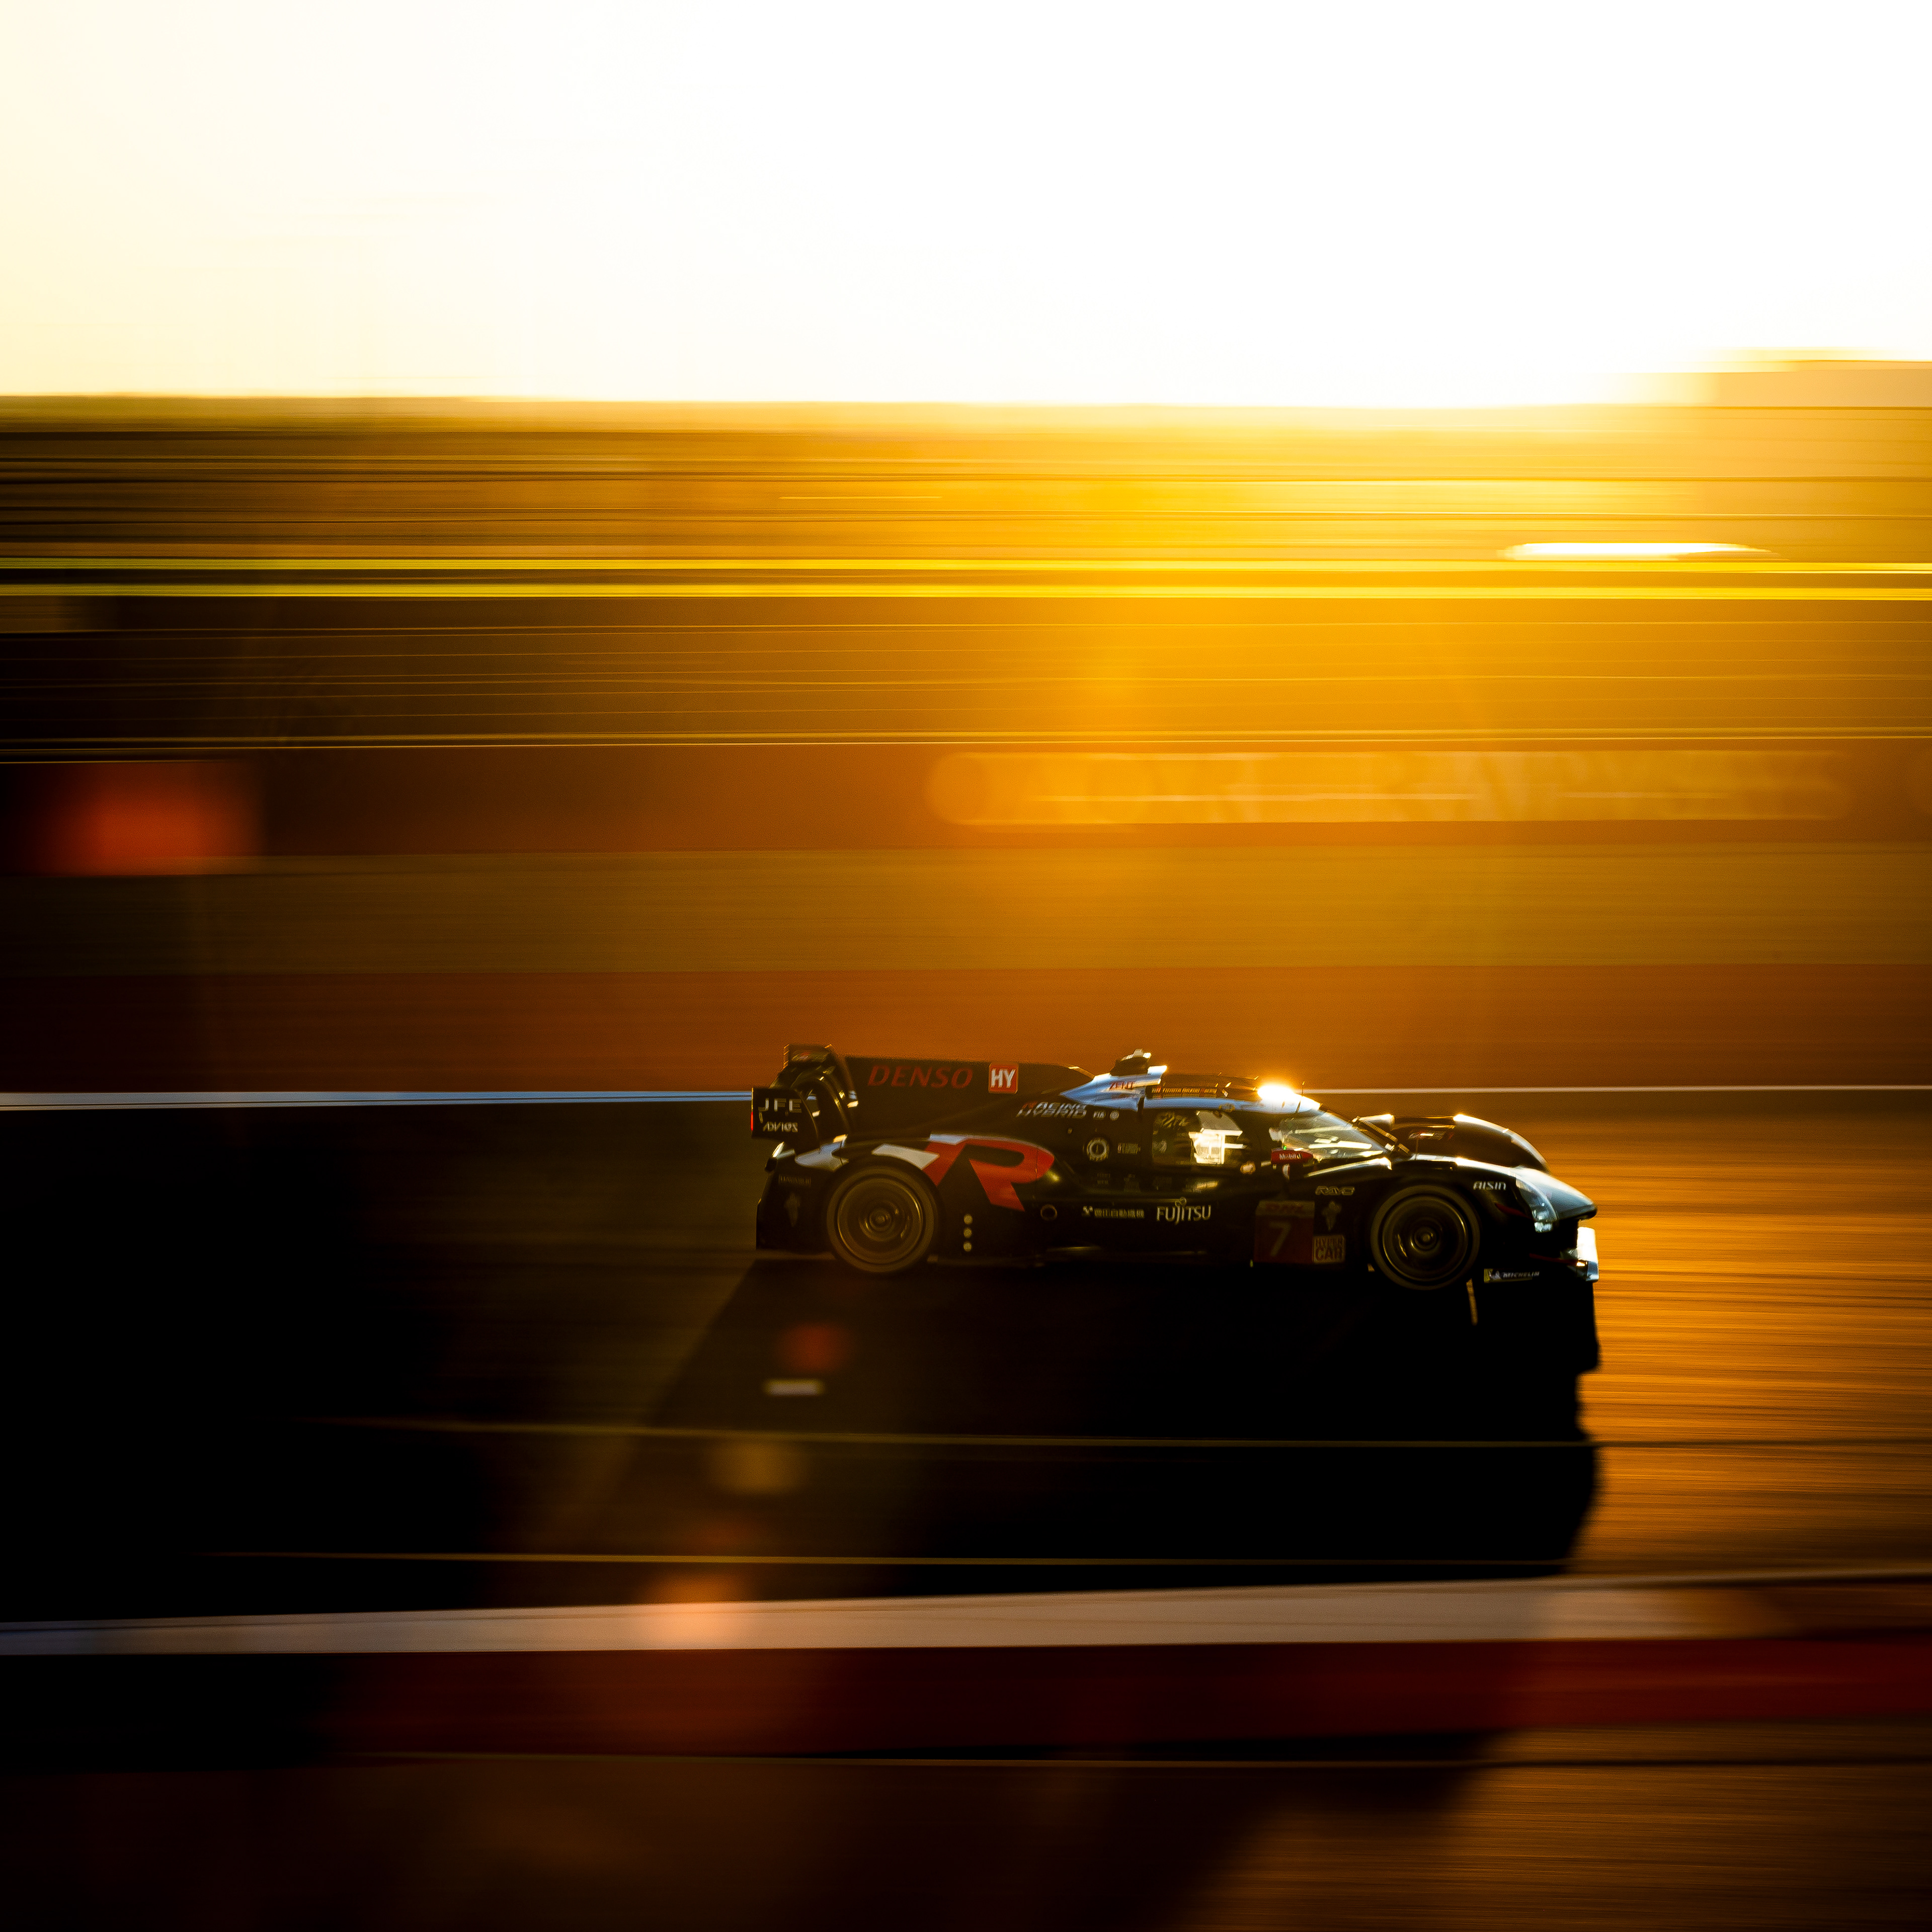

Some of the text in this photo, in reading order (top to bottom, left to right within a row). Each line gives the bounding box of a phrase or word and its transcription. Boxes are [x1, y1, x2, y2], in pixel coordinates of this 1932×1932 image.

[867, 1064, 974, 1089] DENSO
[990, 1068, 1016, 1089] HY
[758, 1097, 802, 1113] JFE
[1473, 1181, 1506, 1190] AISIN
[1156, 1204, 1212, 1226] FUJITSU
[1268, 1221, 1292, 1257] 7
[1315, 1246, 1345, 1260] CAR
